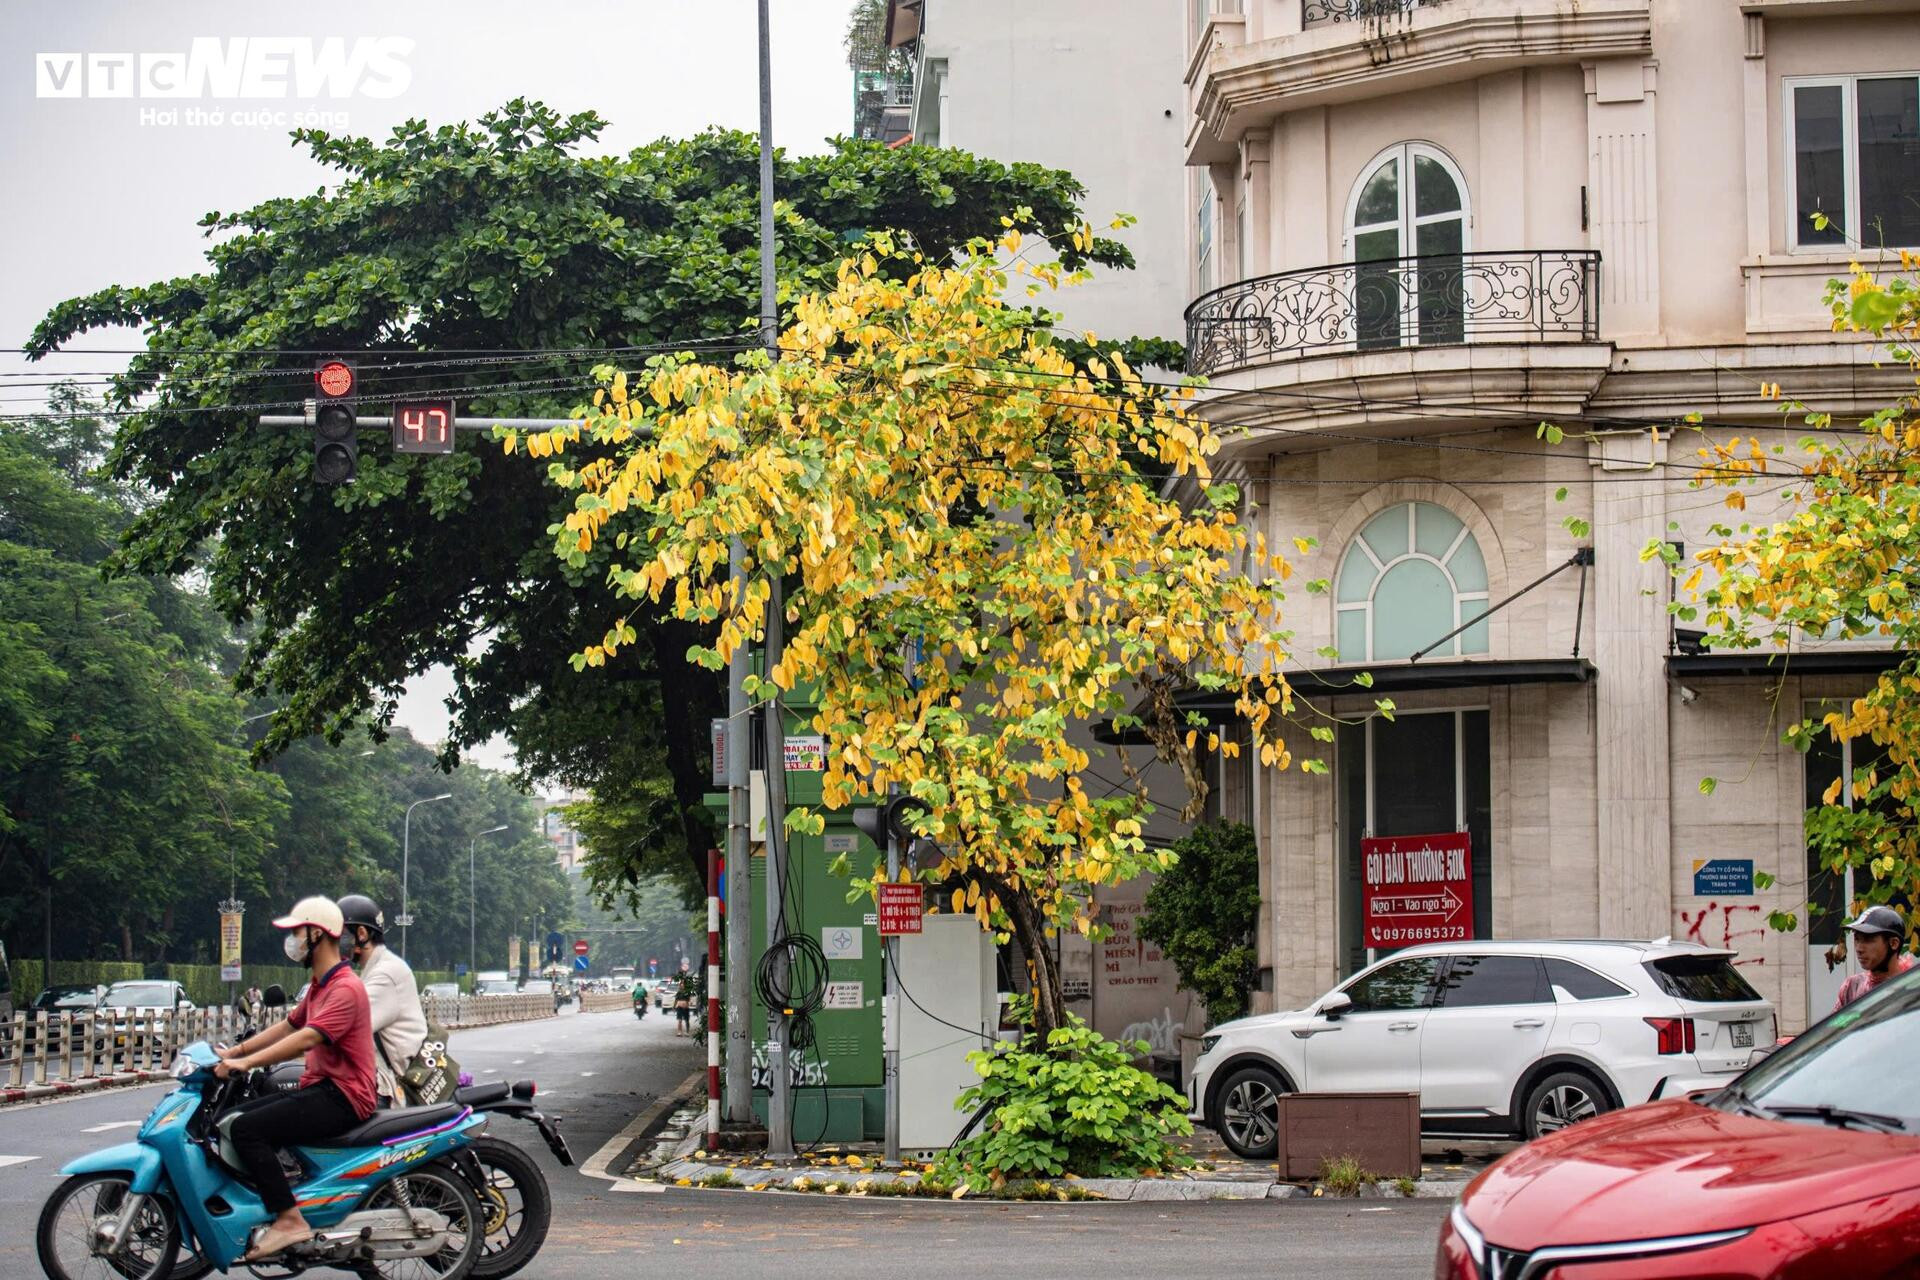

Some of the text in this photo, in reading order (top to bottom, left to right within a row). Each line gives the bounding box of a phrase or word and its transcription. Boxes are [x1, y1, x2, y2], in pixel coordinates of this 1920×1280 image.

[403, 409, 447, 443] 47
[1366, 841, 1466, 891] GỘI ĐẦU THƯỜNG 50K
[1383, 926, 1465, 941] 0976695373
